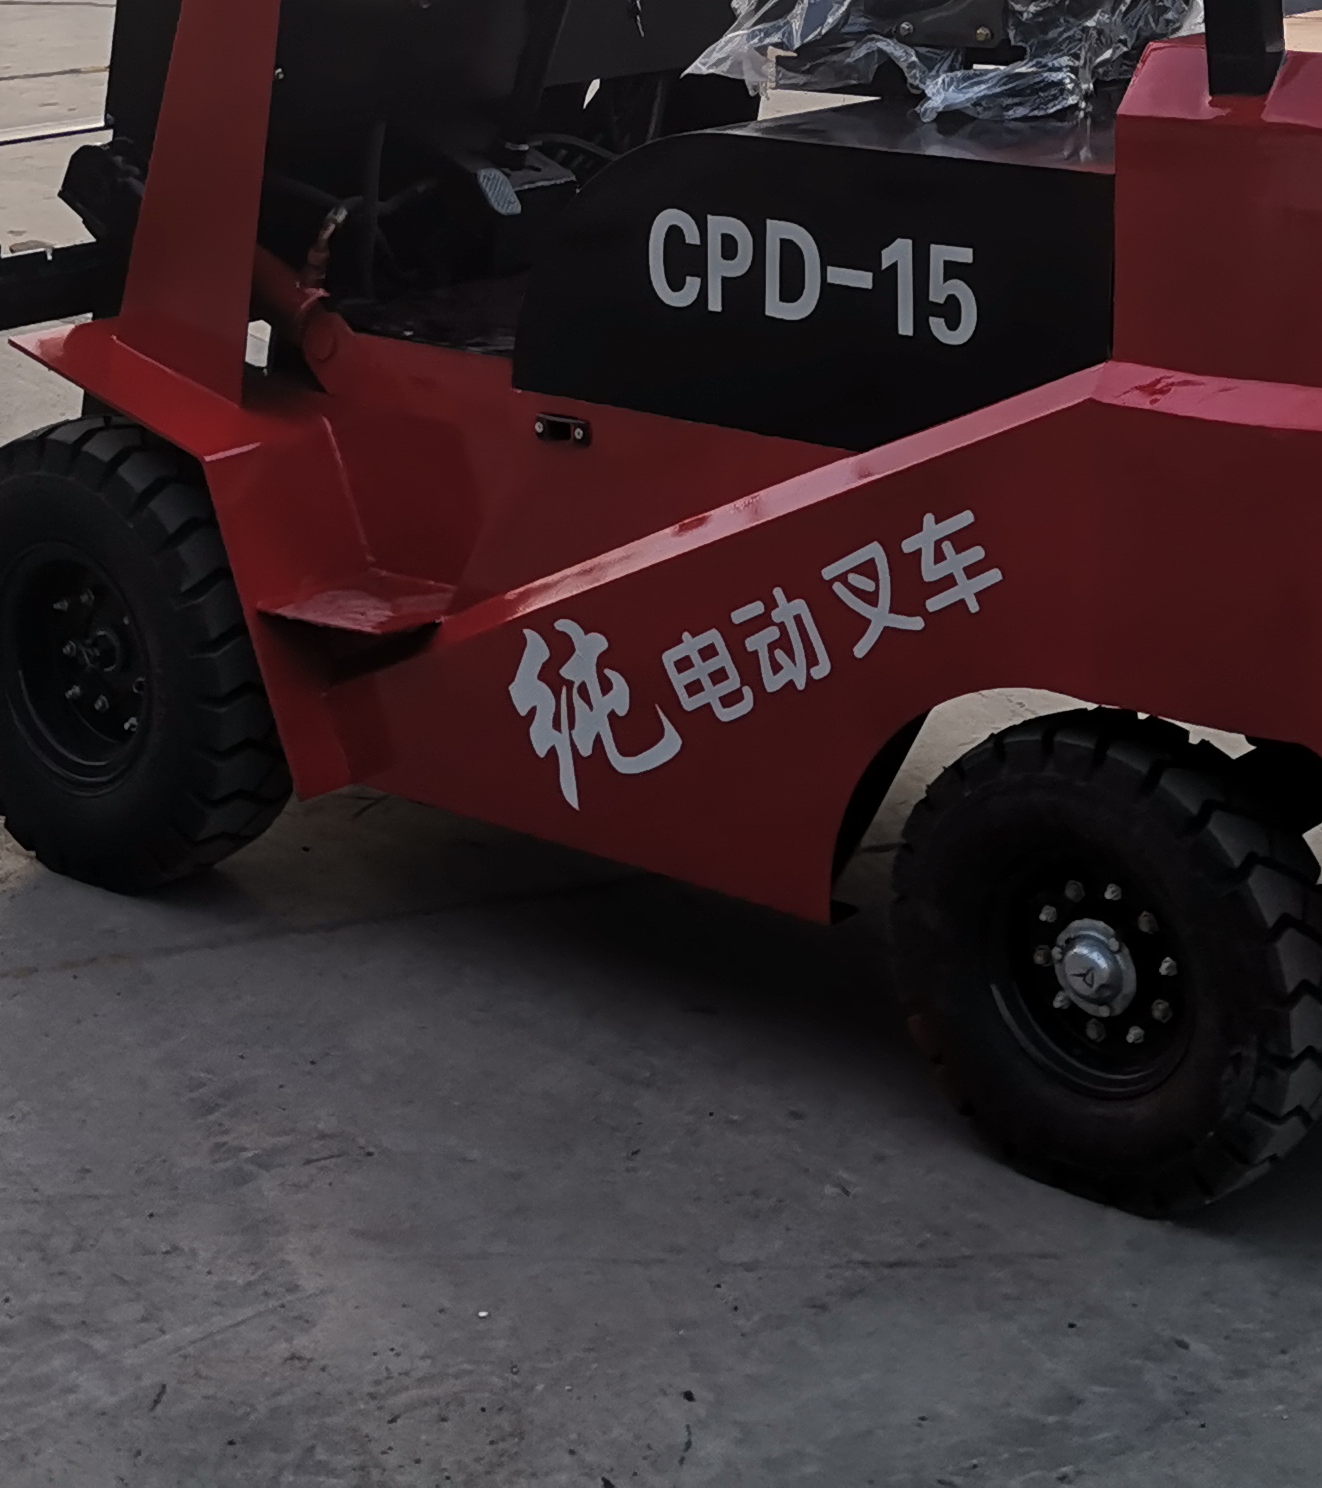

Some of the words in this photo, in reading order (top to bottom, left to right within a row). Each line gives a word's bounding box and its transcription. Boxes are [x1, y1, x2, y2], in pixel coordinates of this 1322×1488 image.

[647, 208, 979, 347] CPD-15
[507, 508, 1004, 812] 纯电动叉车
